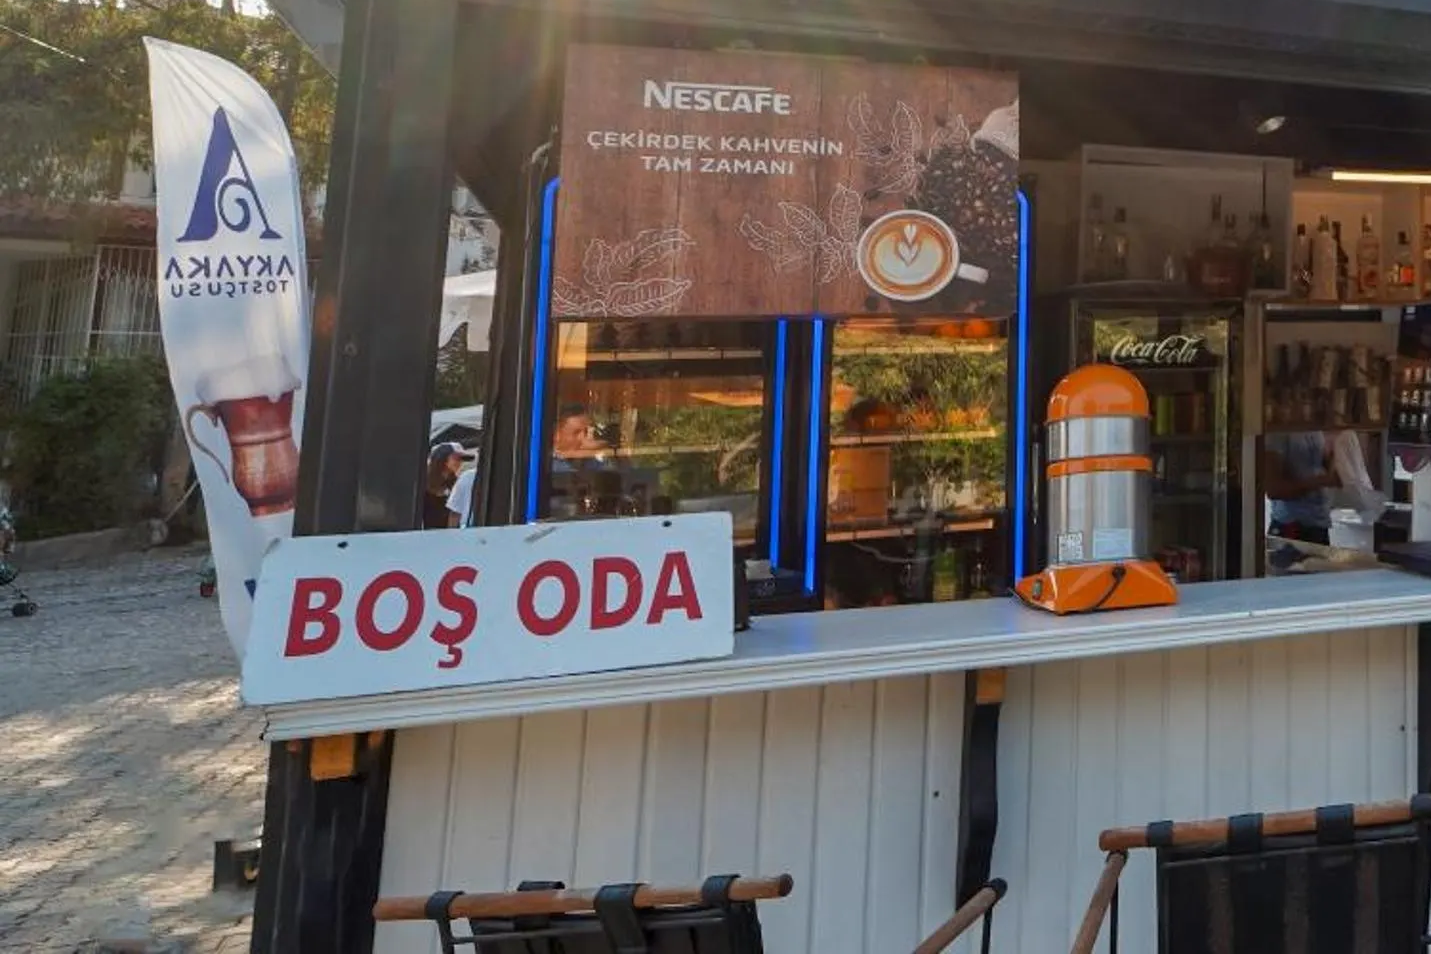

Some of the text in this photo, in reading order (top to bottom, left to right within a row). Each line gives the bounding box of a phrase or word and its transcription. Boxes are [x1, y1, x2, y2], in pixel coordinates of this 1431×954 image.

[587, 130, 843, 155] ÇEKİRDEK KAHVENİN
[640, 156, 794, 175] TAM ZAMANI
[284, 551, 703, 669] BOŞ ODA
